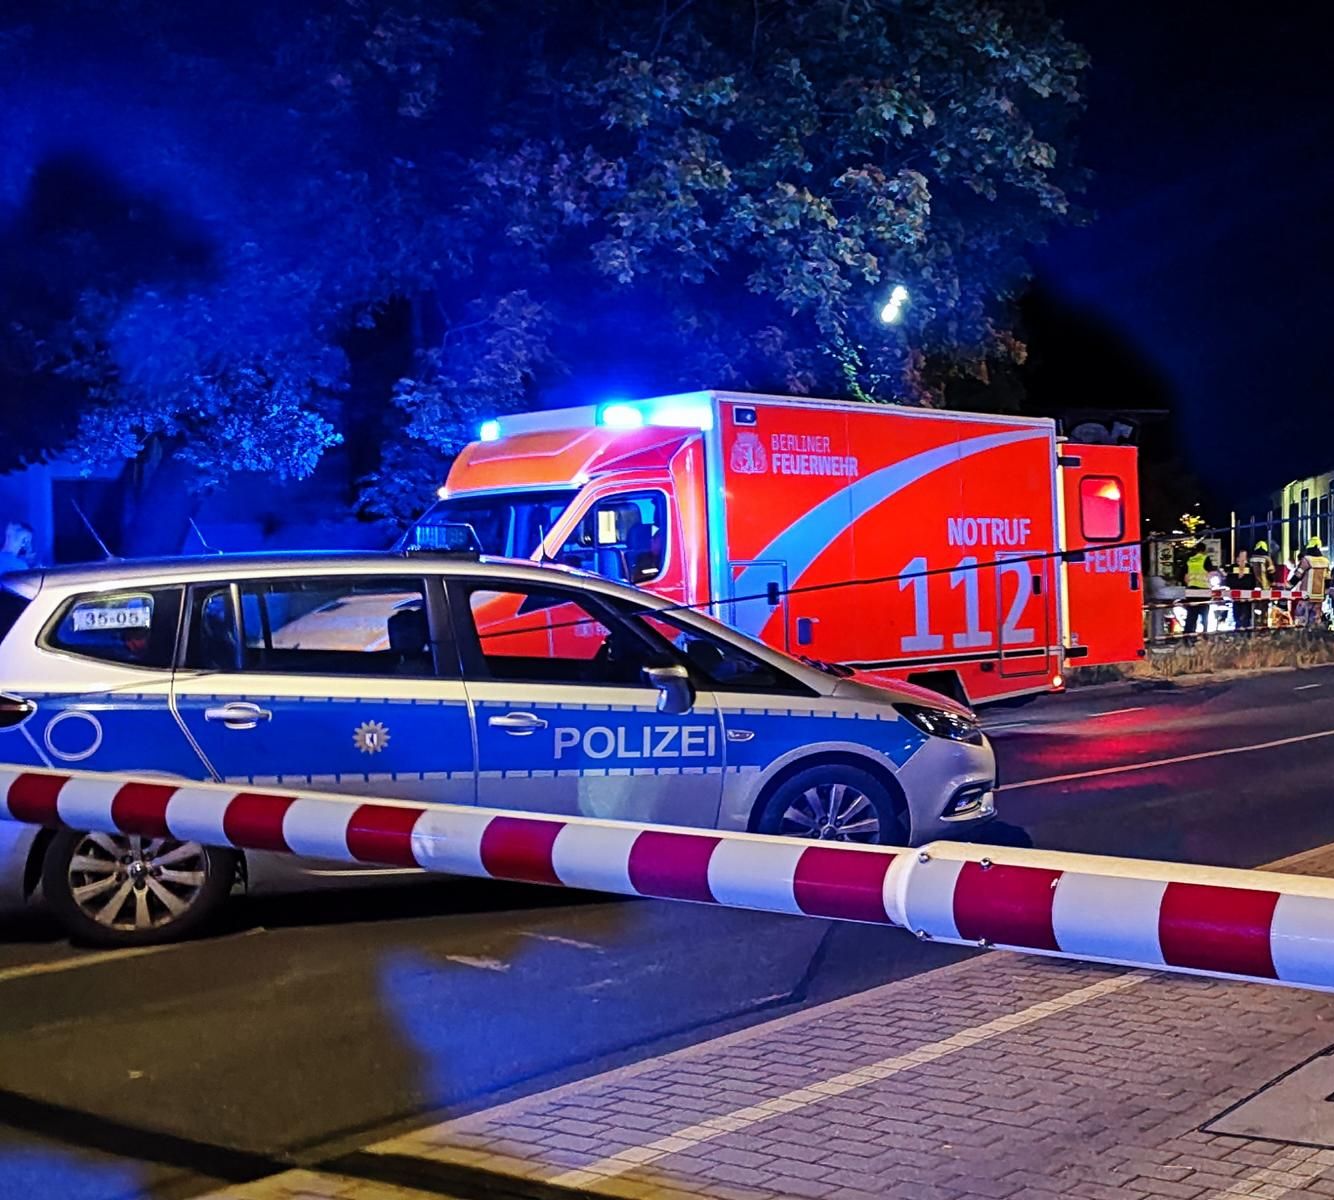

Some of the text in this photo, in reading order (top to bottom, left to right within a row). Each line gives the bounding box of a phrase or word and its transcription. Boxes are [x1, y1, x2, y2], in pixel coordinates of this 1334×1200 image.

[771, 433, 830, 453] BERLINER
[772, 453, 858, 477] FEUERWEHR
[947, 517, 1031, 546] NOTRUF
[899, 555, 1035, 652] 112
[554, 726, 716, 759] POLIZEI
